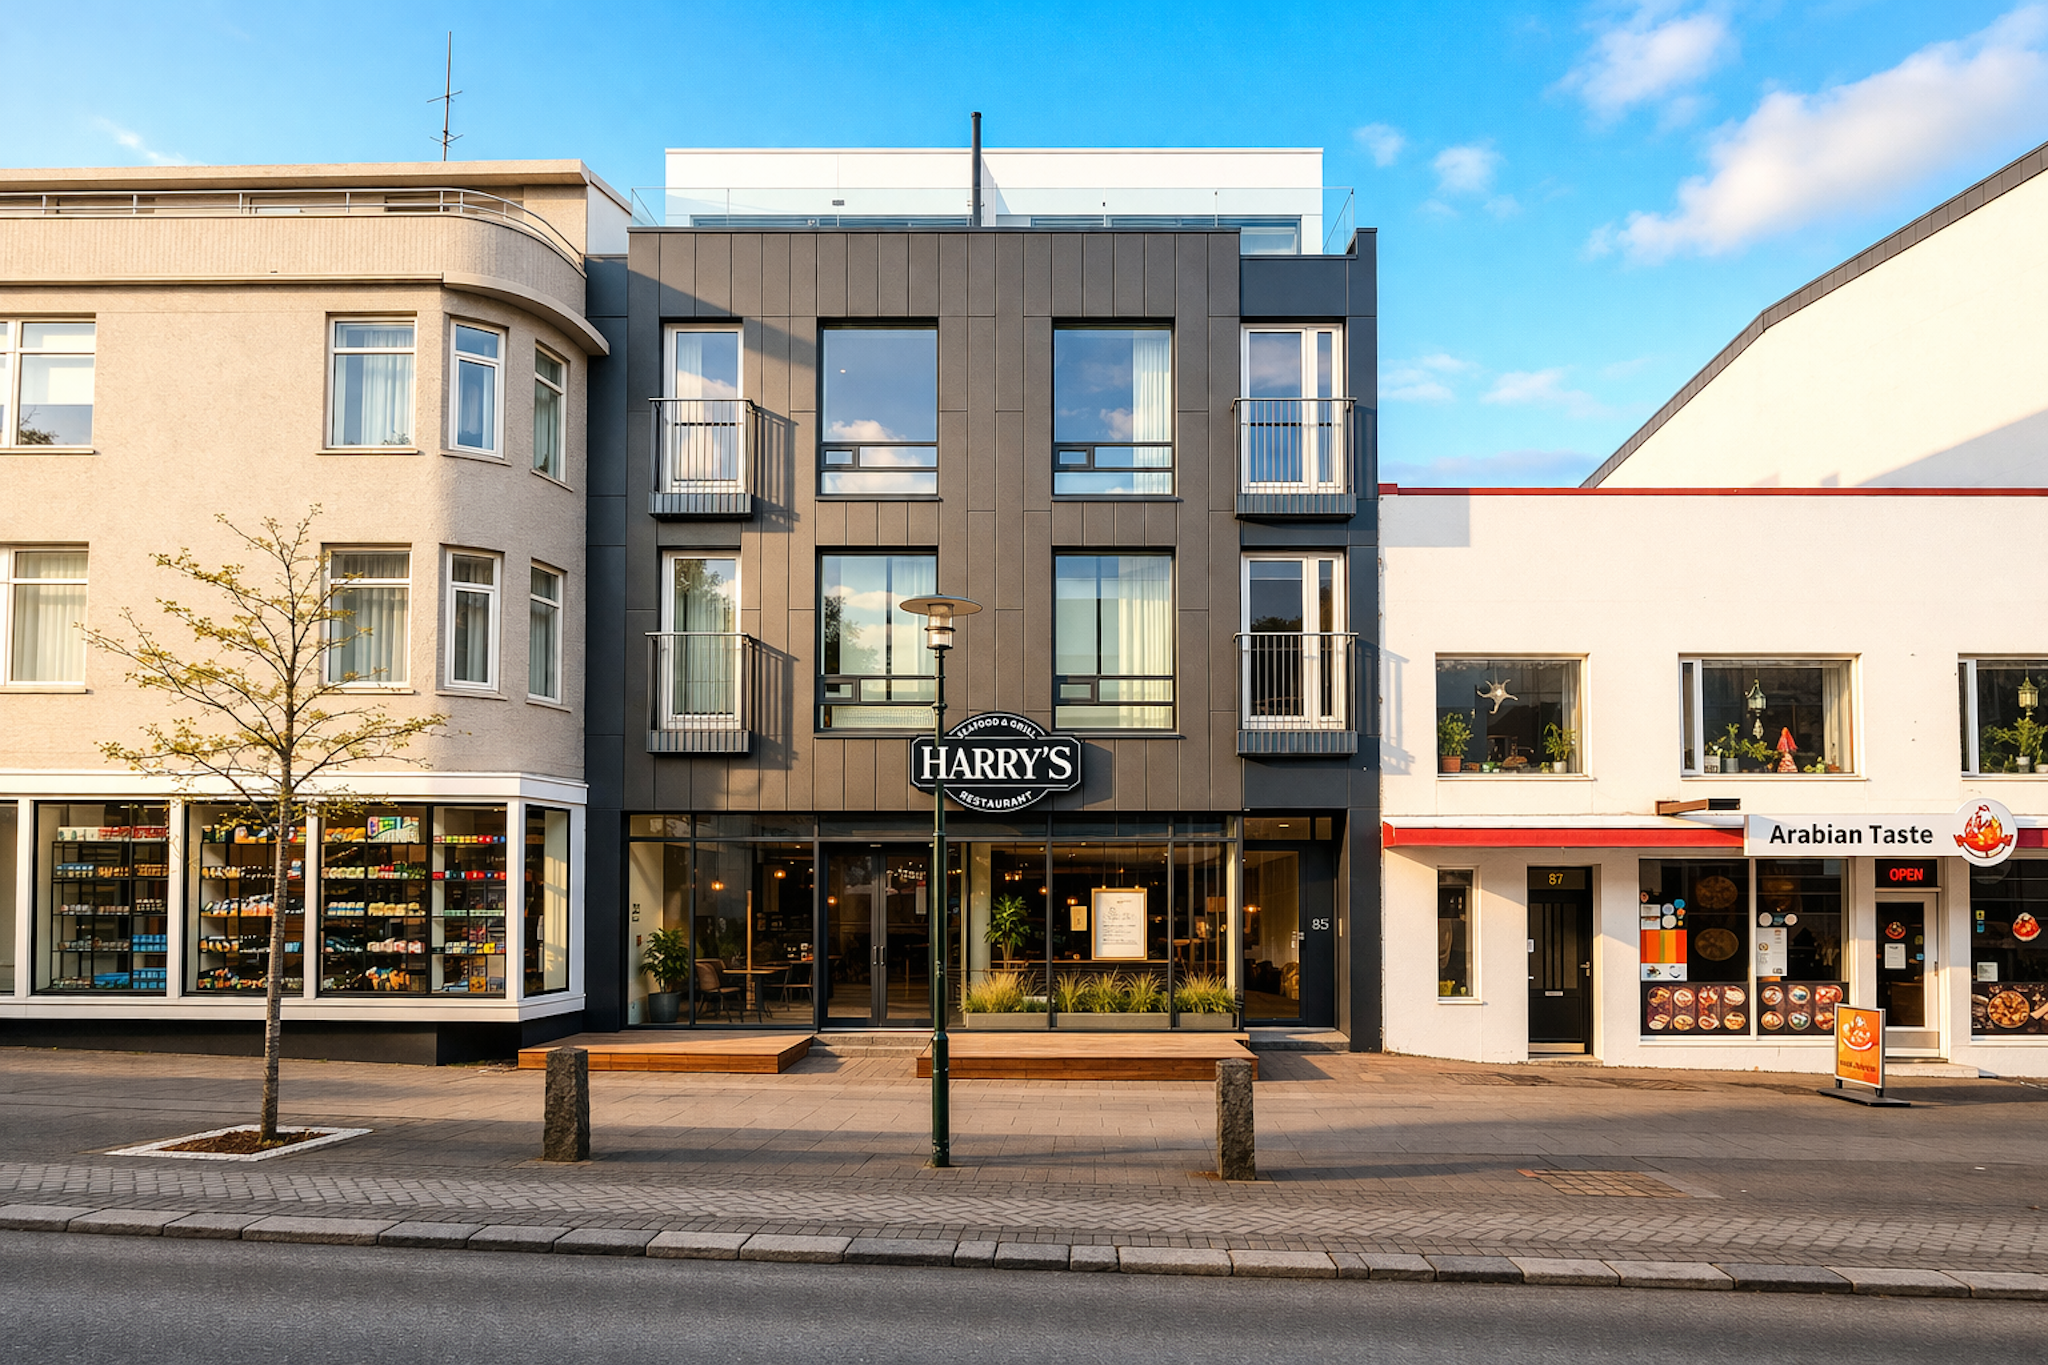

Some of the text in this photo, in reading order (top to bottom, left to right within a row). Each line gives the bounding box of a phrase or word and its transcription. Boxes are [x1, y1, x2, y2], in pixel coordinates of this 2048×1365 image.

[957, 718, 1036, 739] SEAFOOD & GRILL
[921, 745, 1073, 780] HARRY'S
[959, 790, 1032, 809] RESTAURANT
[1769, 824, 1934, 844] Arabian Taste
[1548, 873, 1564, 885] 87
[1889, 868, 1924, 881] OPEN
[1311, 917, 1330, 930] 85
